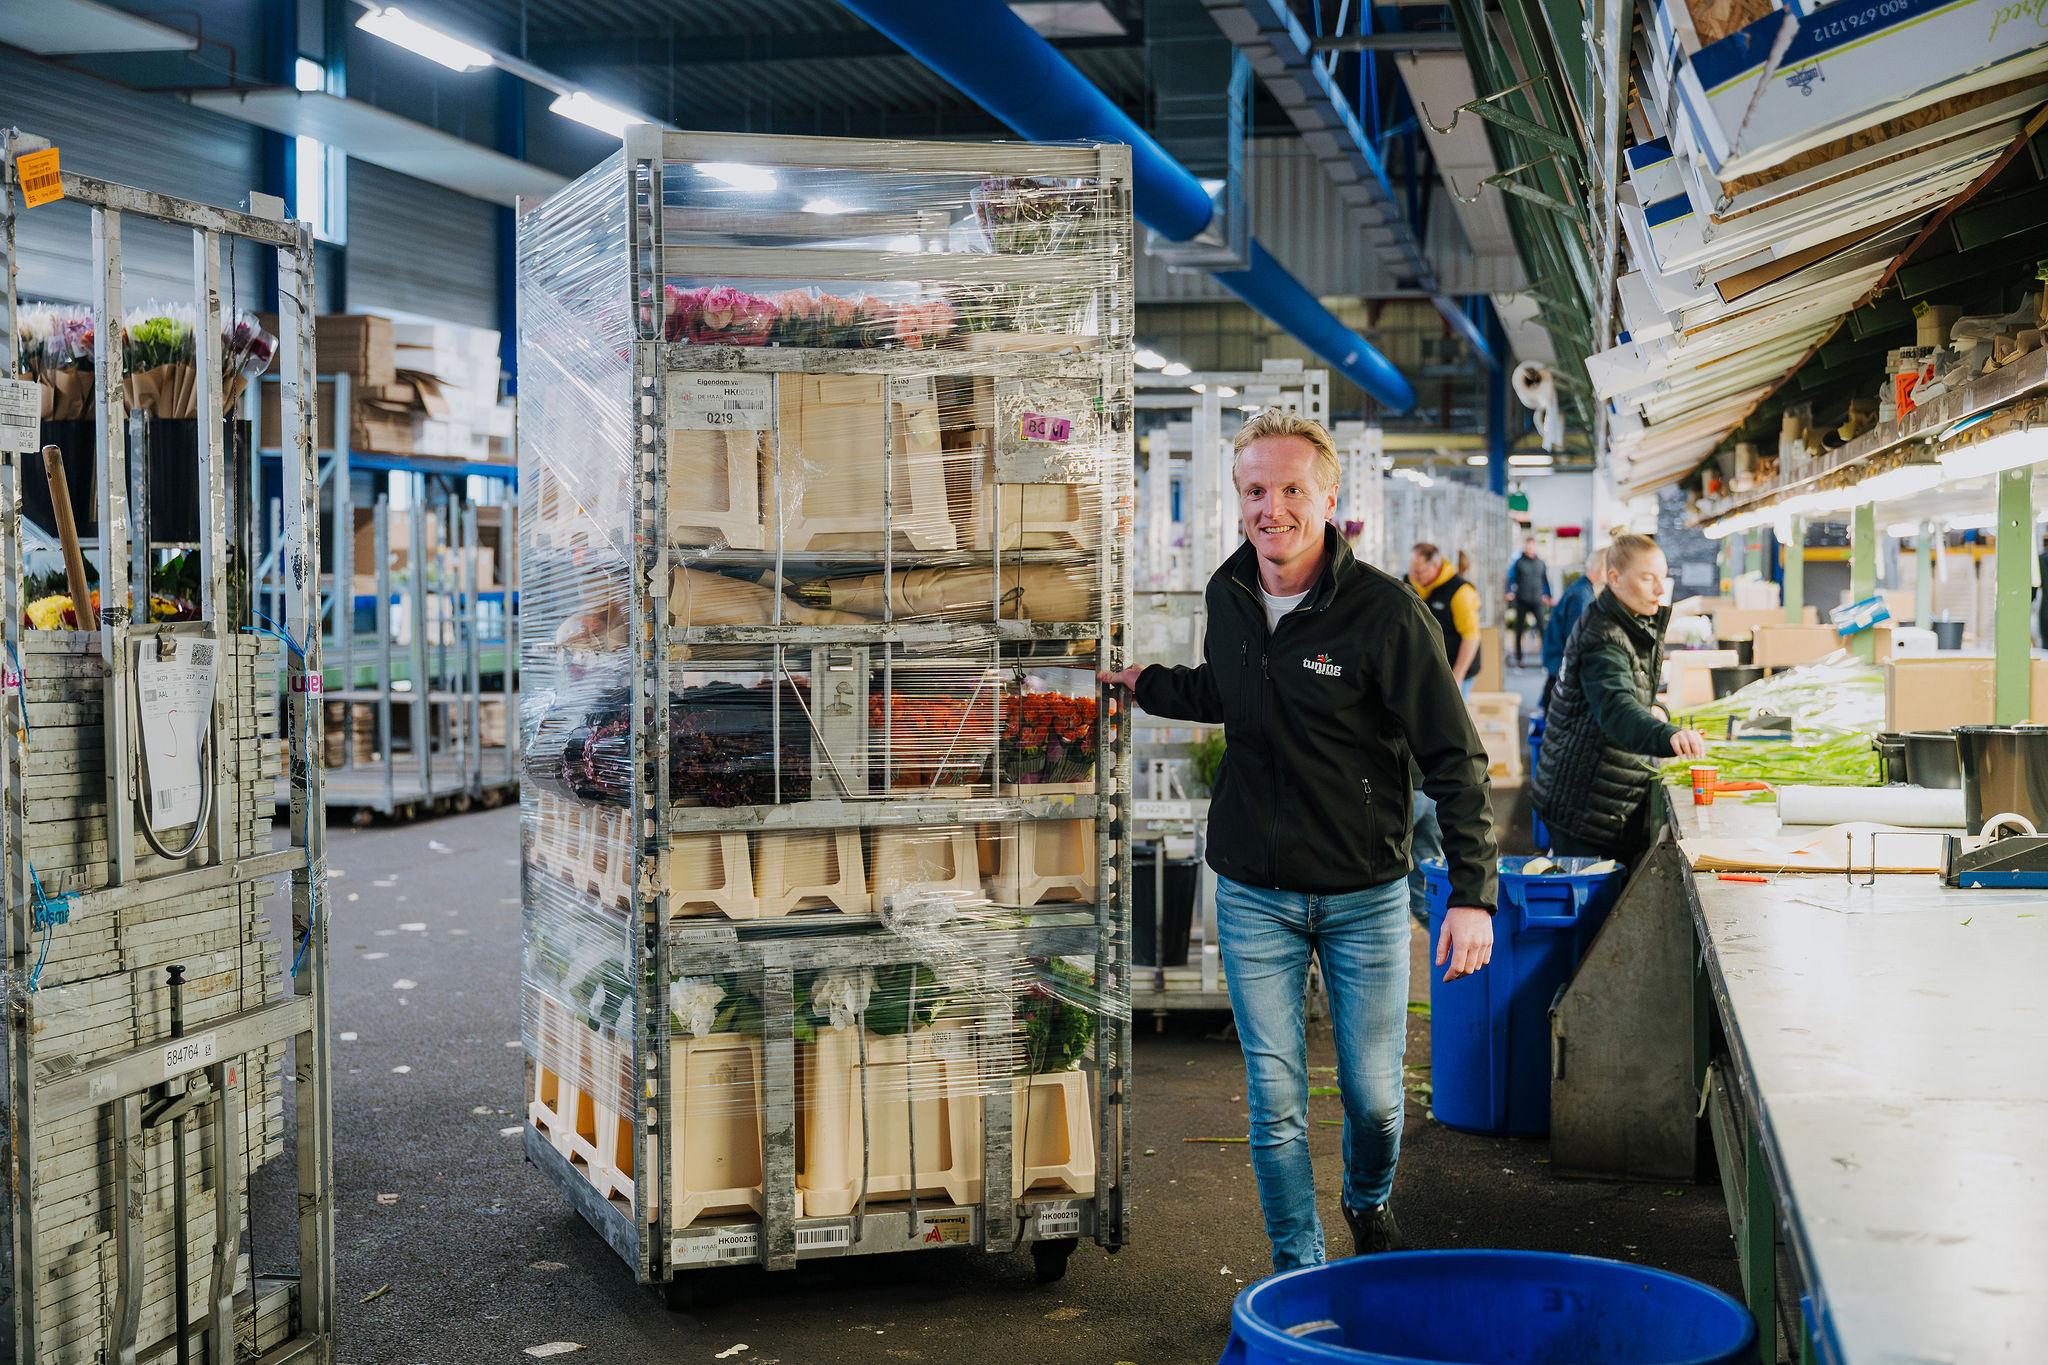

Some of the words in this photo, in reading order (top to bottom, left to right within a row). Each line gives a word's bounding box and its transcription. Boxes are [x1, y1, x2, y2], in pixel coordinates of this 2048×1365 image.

[697, 378, 730, 386] Eigendom
[706, 412, 733, 424] 0219
[1302, 657, 1343, 677] tuning
[166, 1043, 199, 1067] 584764
[1042, 1211, 1079, 1220] HK000219
[718, 1234, 757, 1245] HK000219
